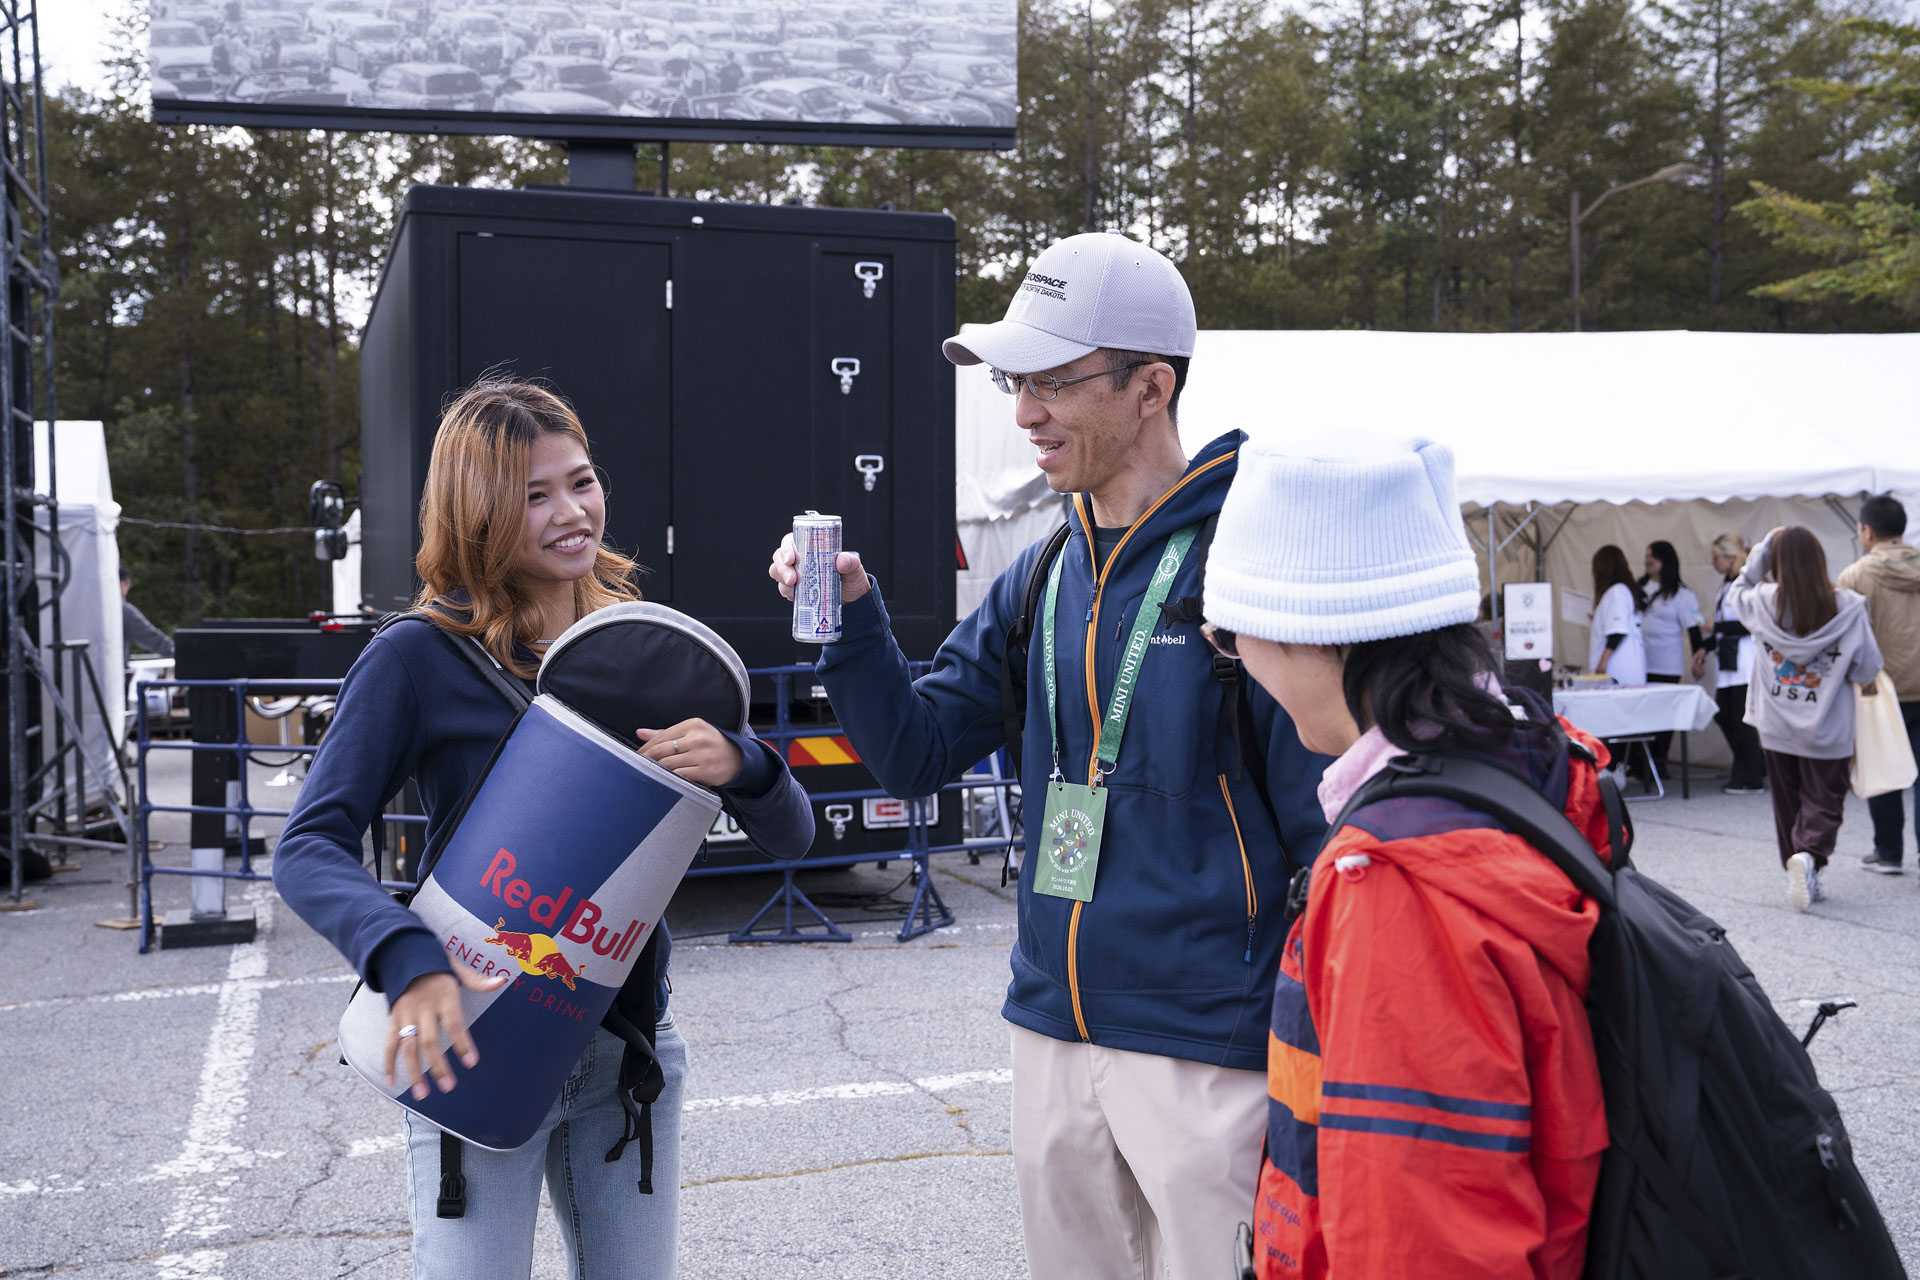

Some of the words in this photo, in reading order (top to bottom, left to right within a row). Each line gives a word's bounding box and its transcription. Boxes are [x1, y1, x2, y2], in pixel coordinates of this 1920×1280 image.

[1040, 289, 1064, 300] DAKOTA
[1045, 628, 1053, 672] JAPAN
[1110, 686, 1128, 723] MINI
[1120, 630, 1148, 684] UNITED.
[1049, 810, 1069, 831] MINI
[1071, 809, 1095, 838] UNITED.
[480, 848, 574, 929] Red
[561, 898, 646, 963] Bull
[529, 987, 589, 1022] DRINK
